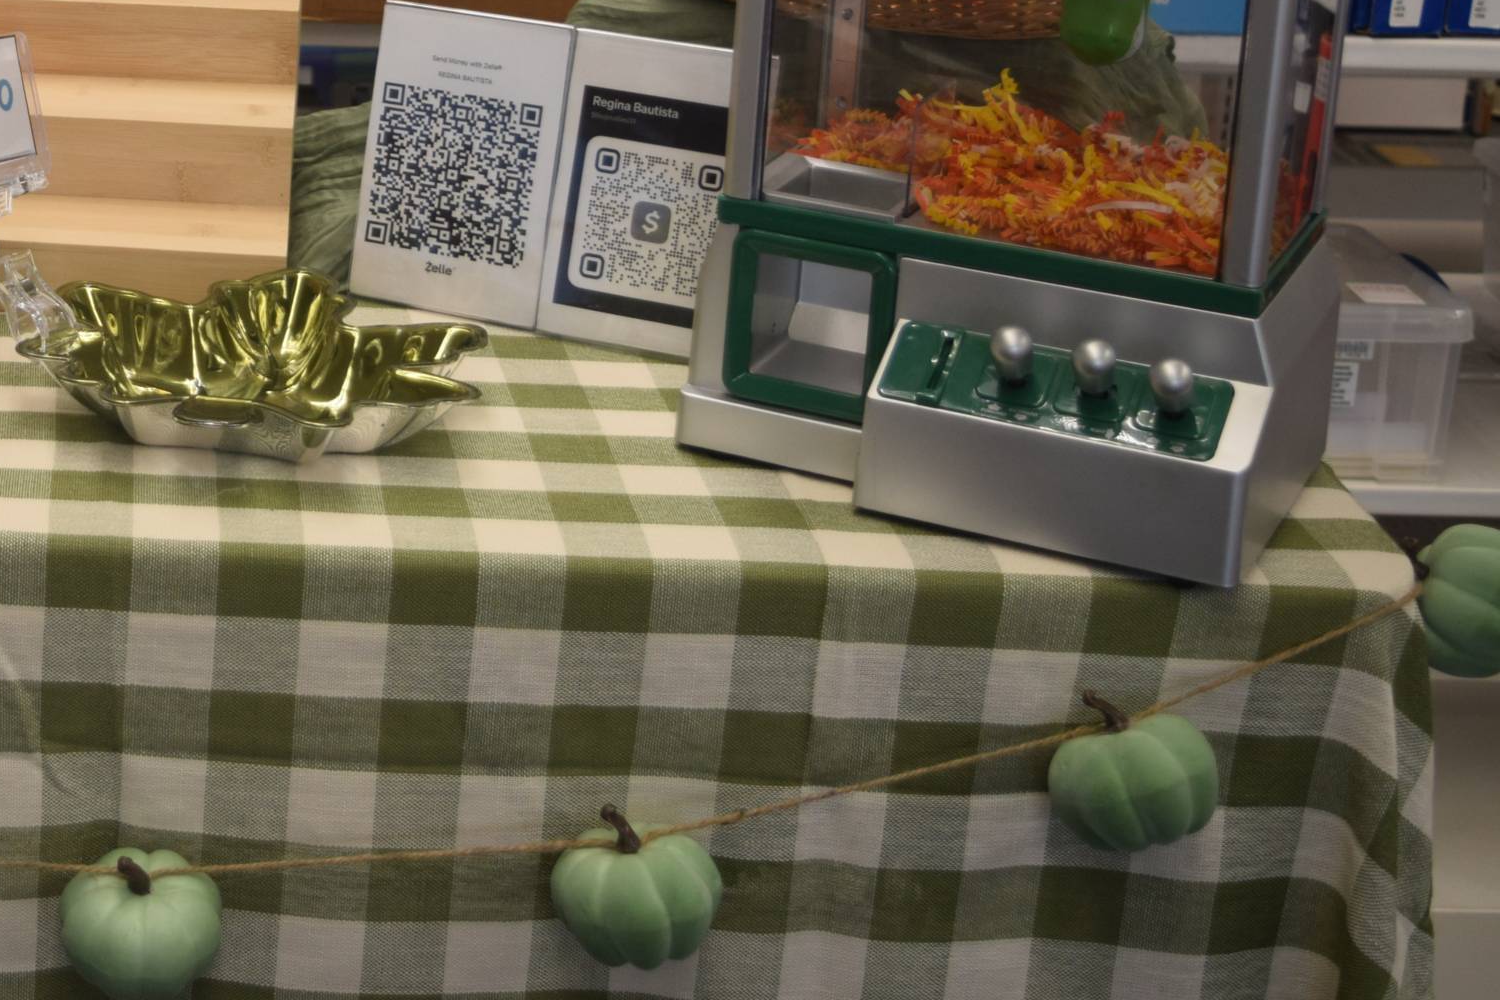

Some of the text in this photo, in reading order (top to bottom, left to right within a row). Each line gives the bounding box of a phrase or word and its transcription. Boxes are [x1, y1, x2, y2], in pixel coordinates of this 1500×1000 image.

[432, 54, 448, 63] Send
[449, 57, 468, 67] Money
[470, 60, 482, 68] with
[462, 74, 493, 84] BAUTISTA
[592, 95, 631, 111] Regina
[633, 102, 679, 119] Bautista
